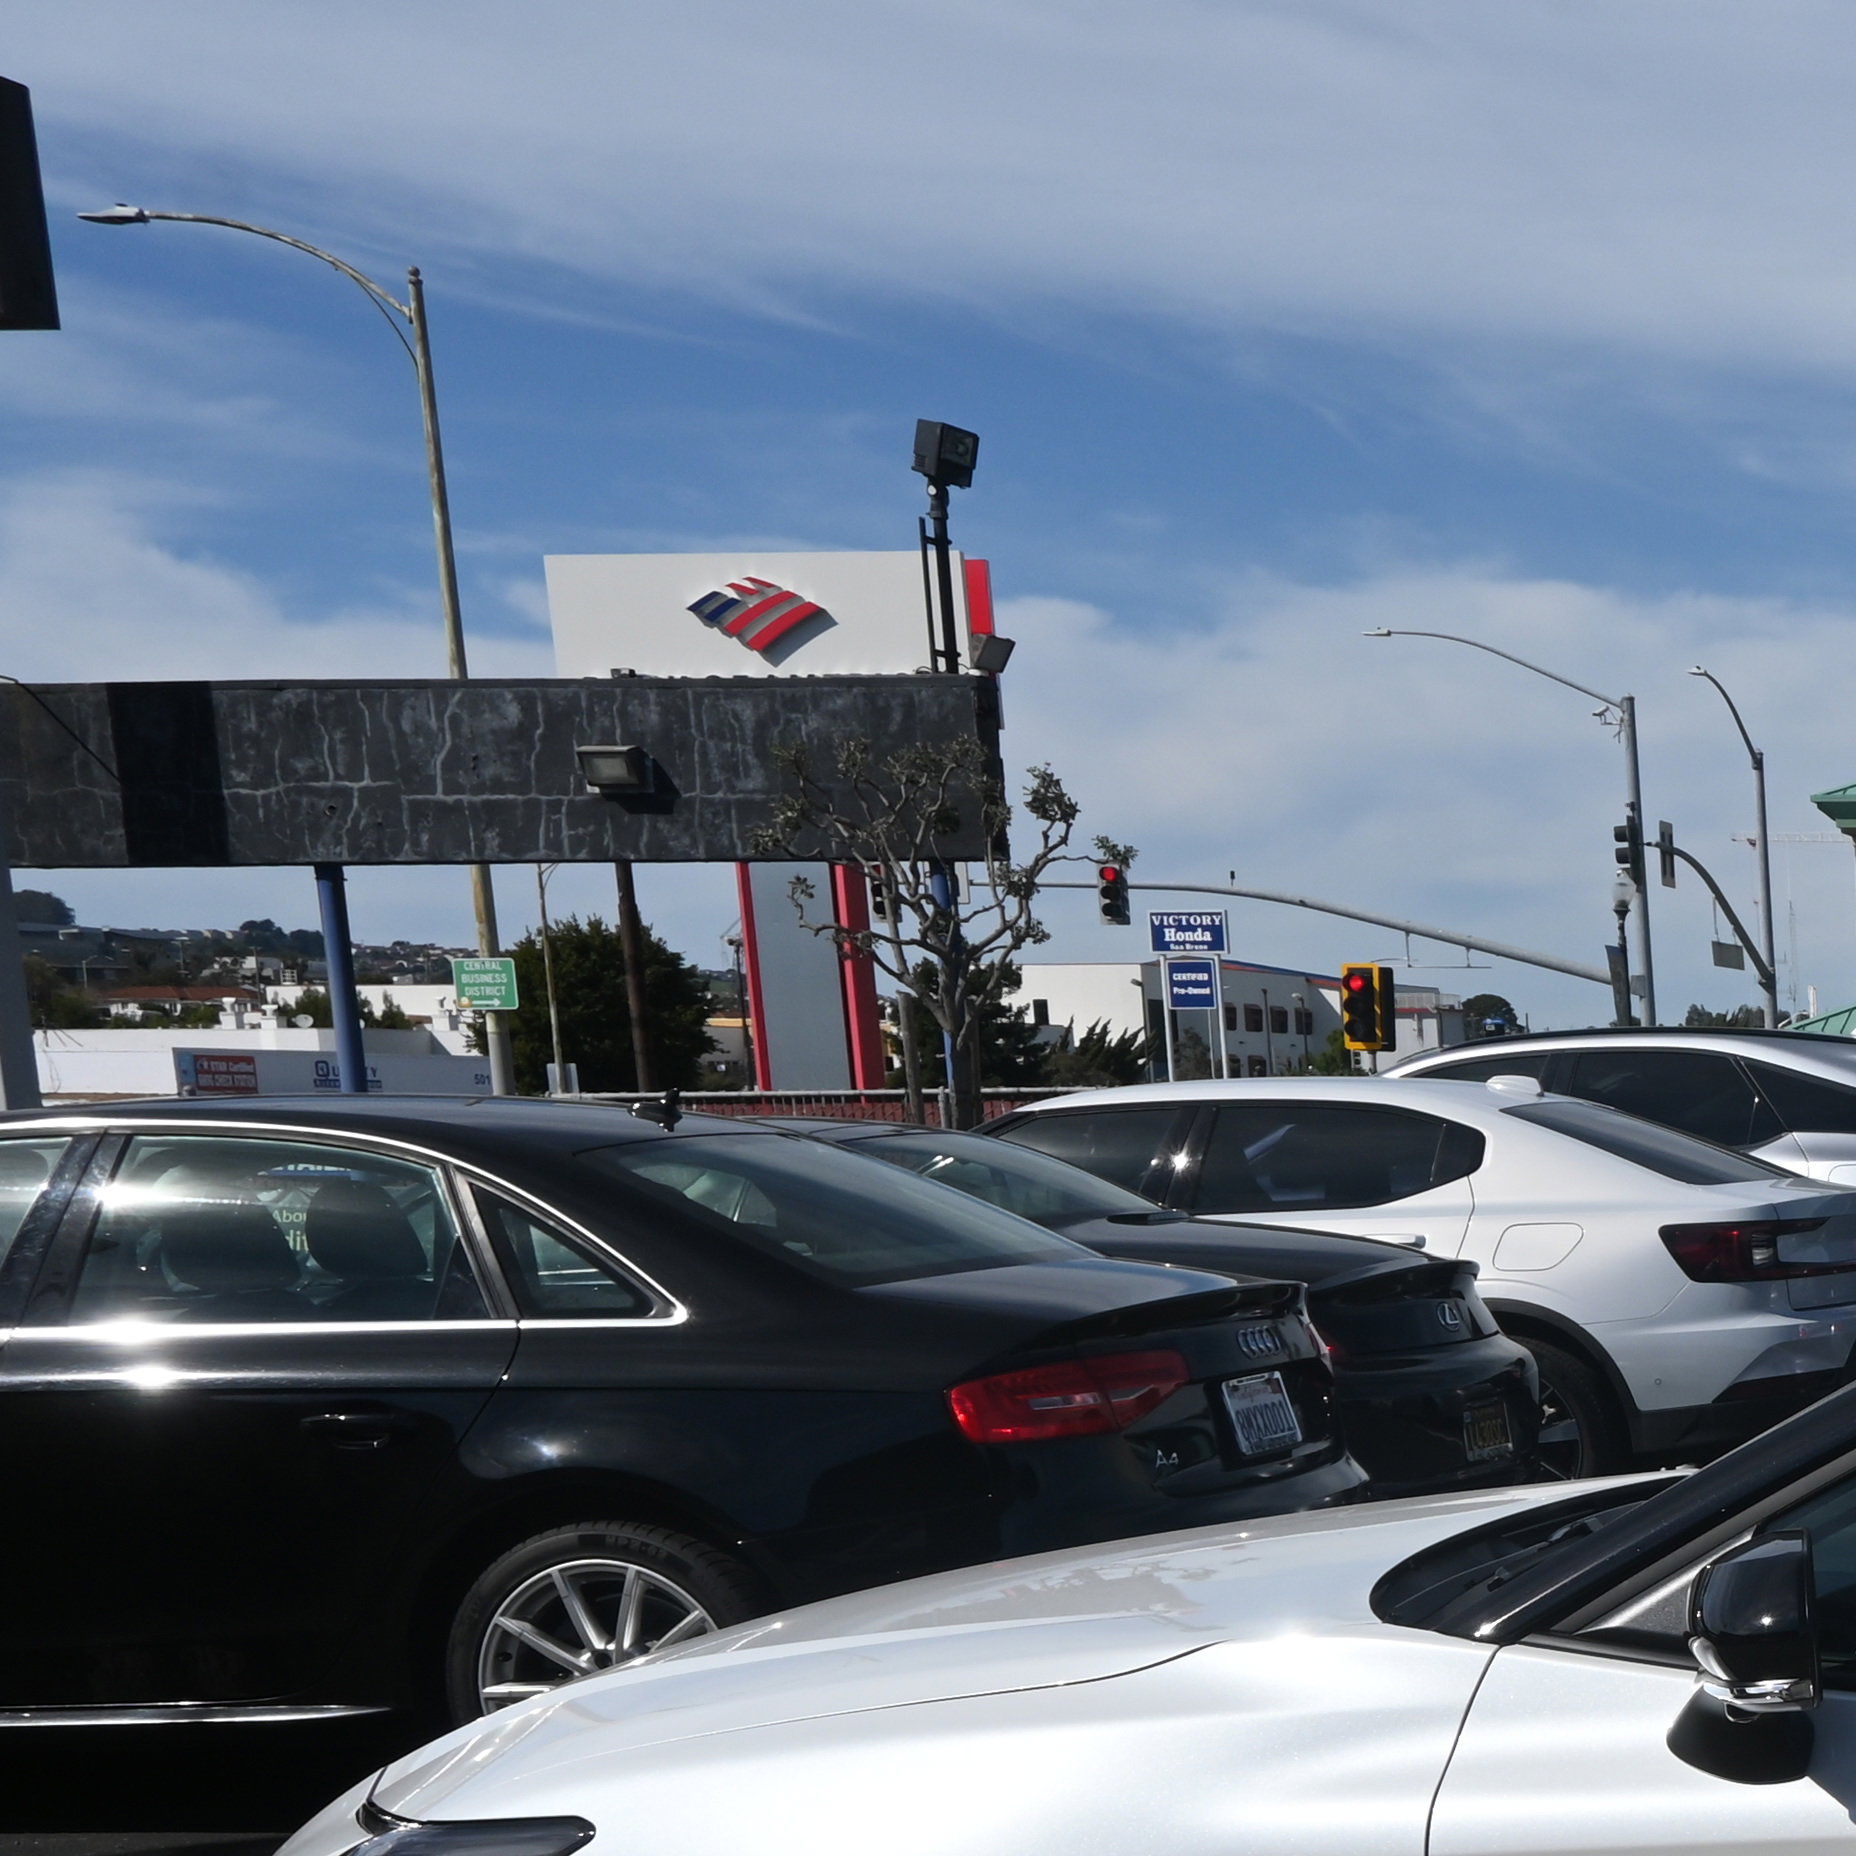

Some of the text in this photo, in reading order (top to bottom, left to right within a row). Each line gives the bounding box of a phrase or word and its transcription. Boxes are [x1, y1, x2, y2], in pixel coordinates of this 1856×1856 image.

[1151, 914, 1222, 926] VICTORY
[1163, 927, 1212, 941] Honda
[463, 961, 503, 971] CENTRAL
[461, 973, 508, 984] BUSINESS
[1172, 972, 1209, 981] CERTIFIED
[464, 986, 506, 997] DISTRICT
[1155, 1449, 1179, 1469] A4
